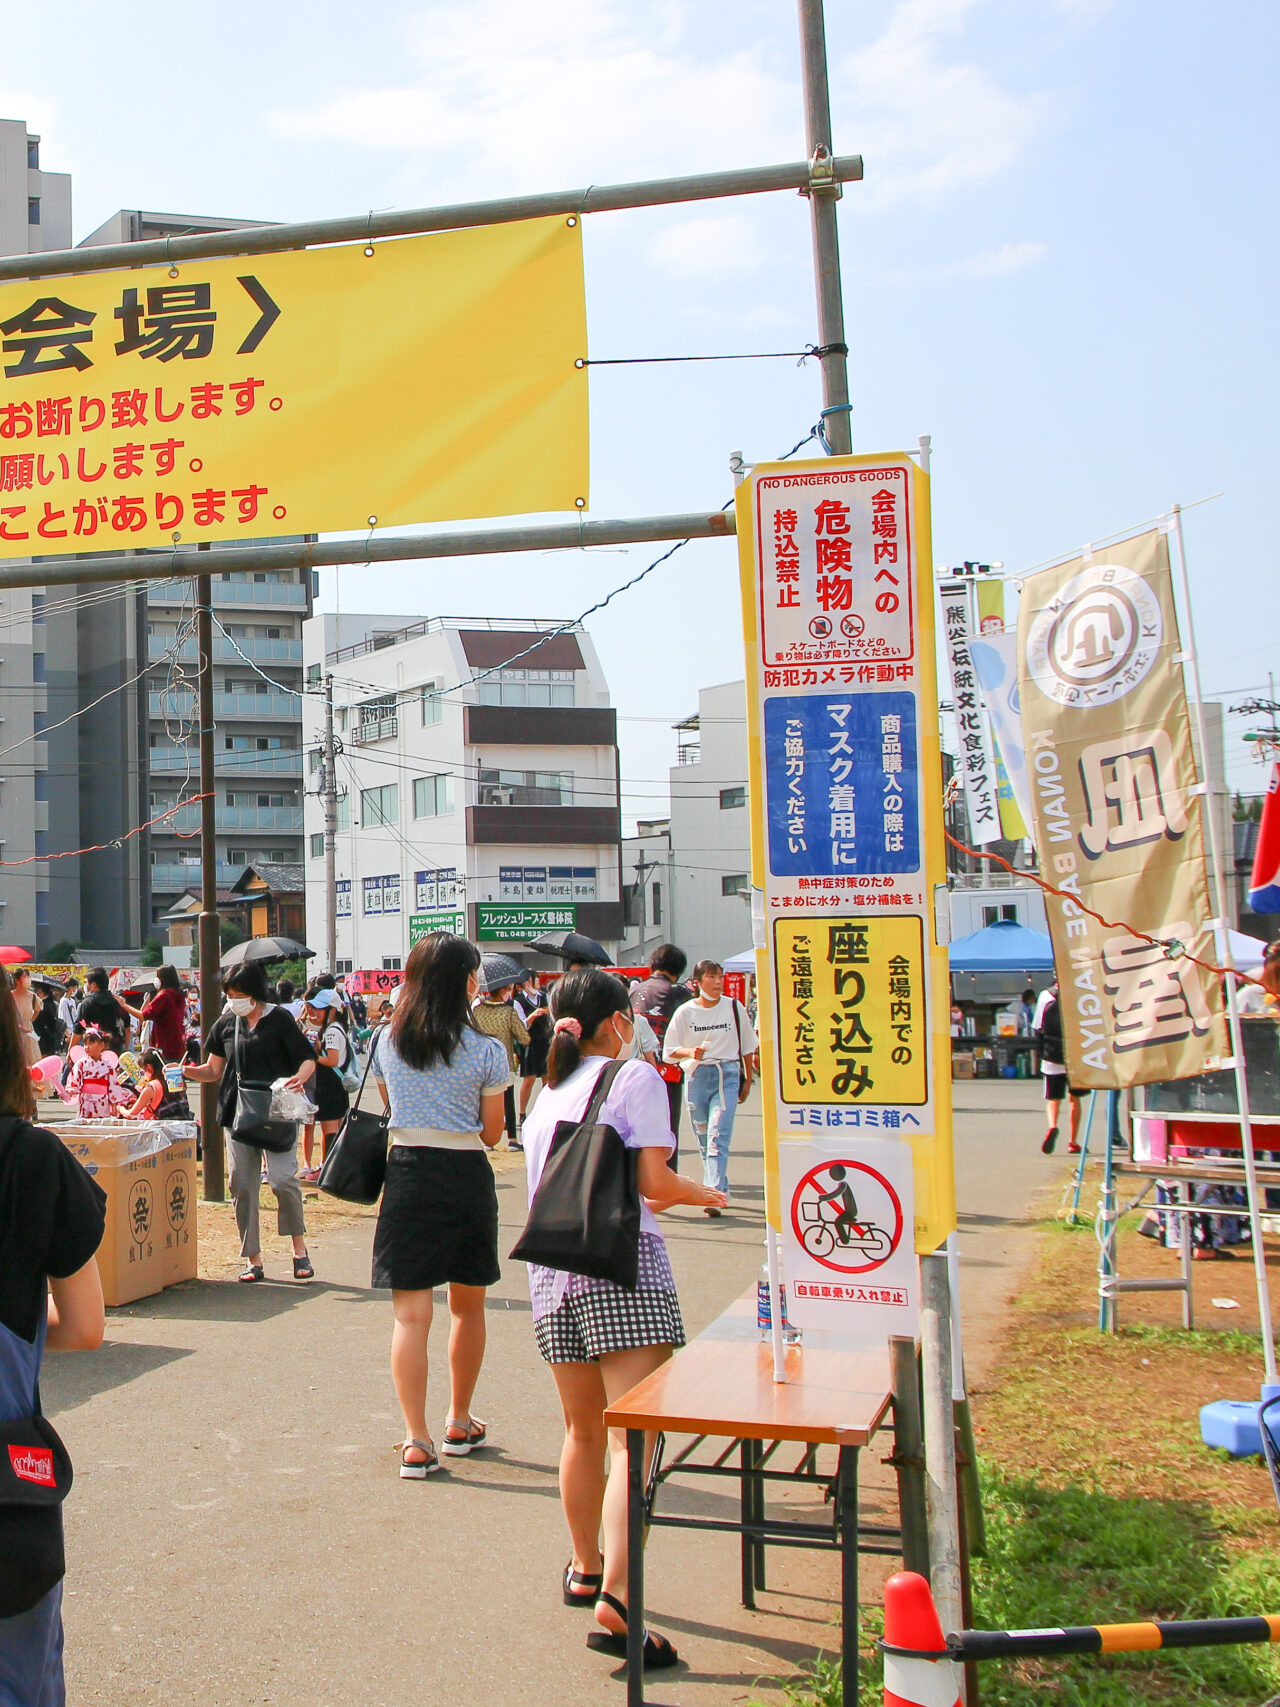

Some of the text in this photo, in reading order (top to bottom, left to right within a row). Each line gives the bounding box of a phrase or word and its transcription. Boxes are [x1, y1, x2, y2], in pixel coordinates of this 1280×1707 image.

[763, 470, 901, 489] NO DANGEROUS GOODS
[774, 508, 801, 609] 持込禁止
[814, 500, 854, 612] 危険物
[872, 489, 900, 614] 会場内への
[764, 664, 914, 688] 防犯カメラ作動中
[775, 647, 901, 662] 乗り物は必ず降りてください
[789, 638, 886, 652] スケートボードなどの
[946, 605, 995, 824] 熊谷伝統文化食彩フェス
[784, 718, 807, 854] ご協力ください
[826, 704, 857, 866] マスク着用に
[880, 714, 905, 852] 商品購入の際は
[798, 876, 895, 890] 熱中症対策のため
[693, 1022, 728, 1032] Innocent
[791, 934, 817, 1087] ご遠慮ください
[826, 922, 874, 1099] 座り込み
[887, 954, 913, 1066] 会場内での
[789, 1109, 921, 1129] ゴミはゴミ箱へ
[797, 1283, 904, 1304] 自転車乗り入れ禁止
